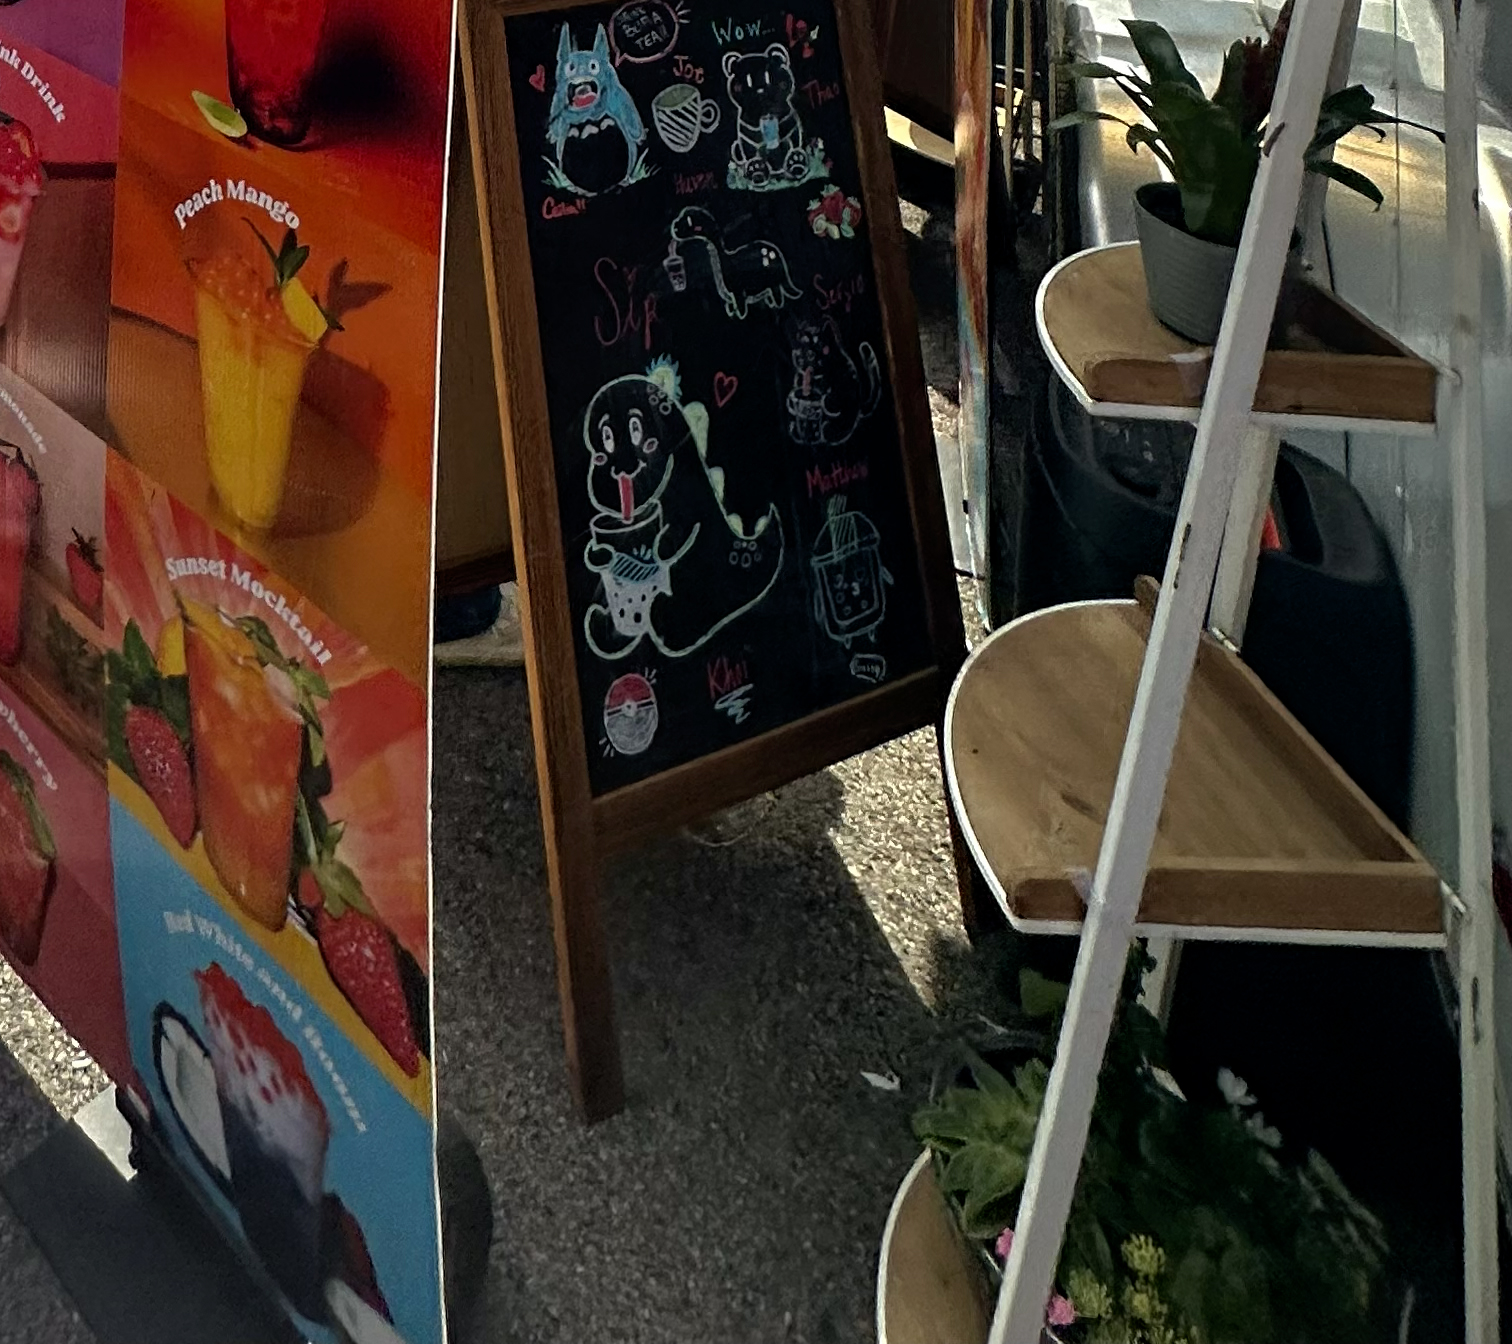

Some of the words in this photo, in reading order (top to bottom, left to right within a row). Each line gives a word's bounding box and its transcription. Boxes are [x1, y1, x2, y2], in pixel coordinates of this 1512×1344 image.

[21, 61, 66, 123] Drink
[226, 178, 300, 230] Mango
[165, 557, 227, 581] Sunset
[230, 562, 333, 667] Mocktail
